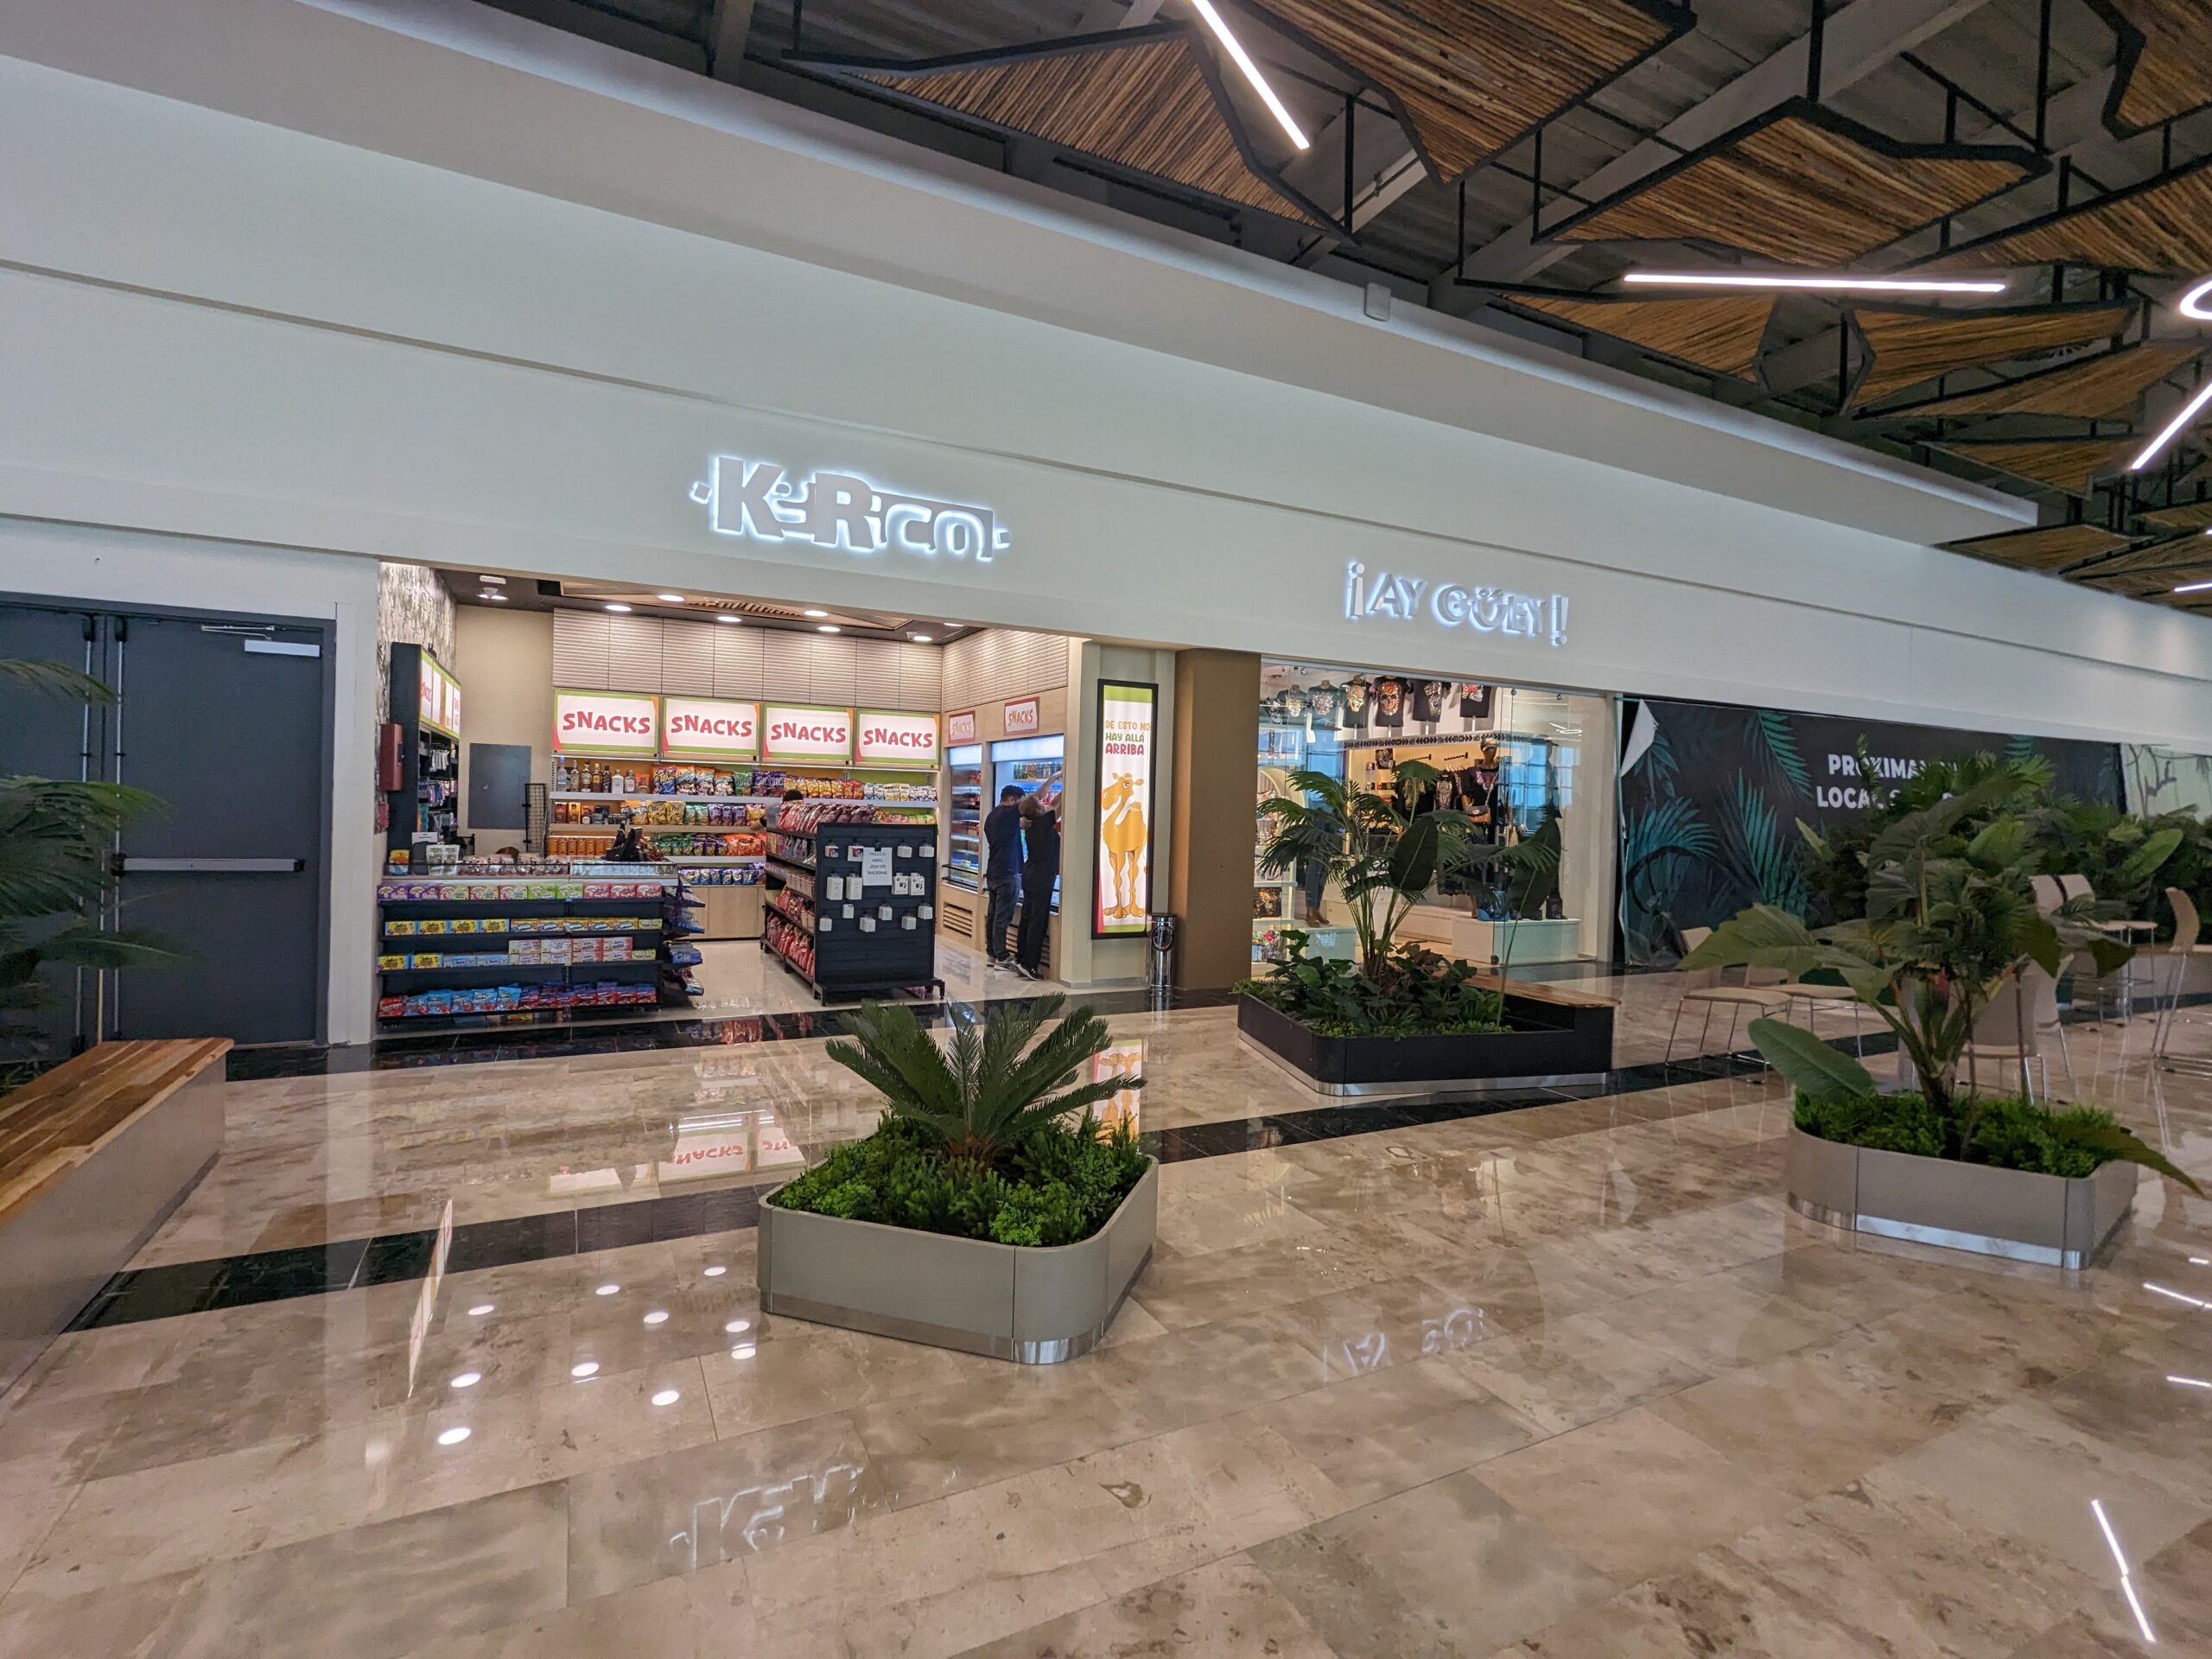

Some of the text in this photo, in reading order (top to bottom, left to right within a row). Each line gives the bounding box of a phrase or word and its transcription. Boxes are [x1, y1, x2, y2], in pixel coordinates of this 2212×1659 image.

[563, 710, 651, 734] SNACKS
[671, 715, 753, 737] SNACKS
[1007, 709, 1033, 726] SNACKS
[1105, 720, 1150, 731] DE ESTO NO
[771, 722, 846, 743] SNACKS
[951, 720, 971, 735] SNACKS
[863, 728, 933, 747] SNACKS
[1105, 732, 1144, 742] HAY ALLÁ
[1105, 742, 1144, 755] ARRIBA
